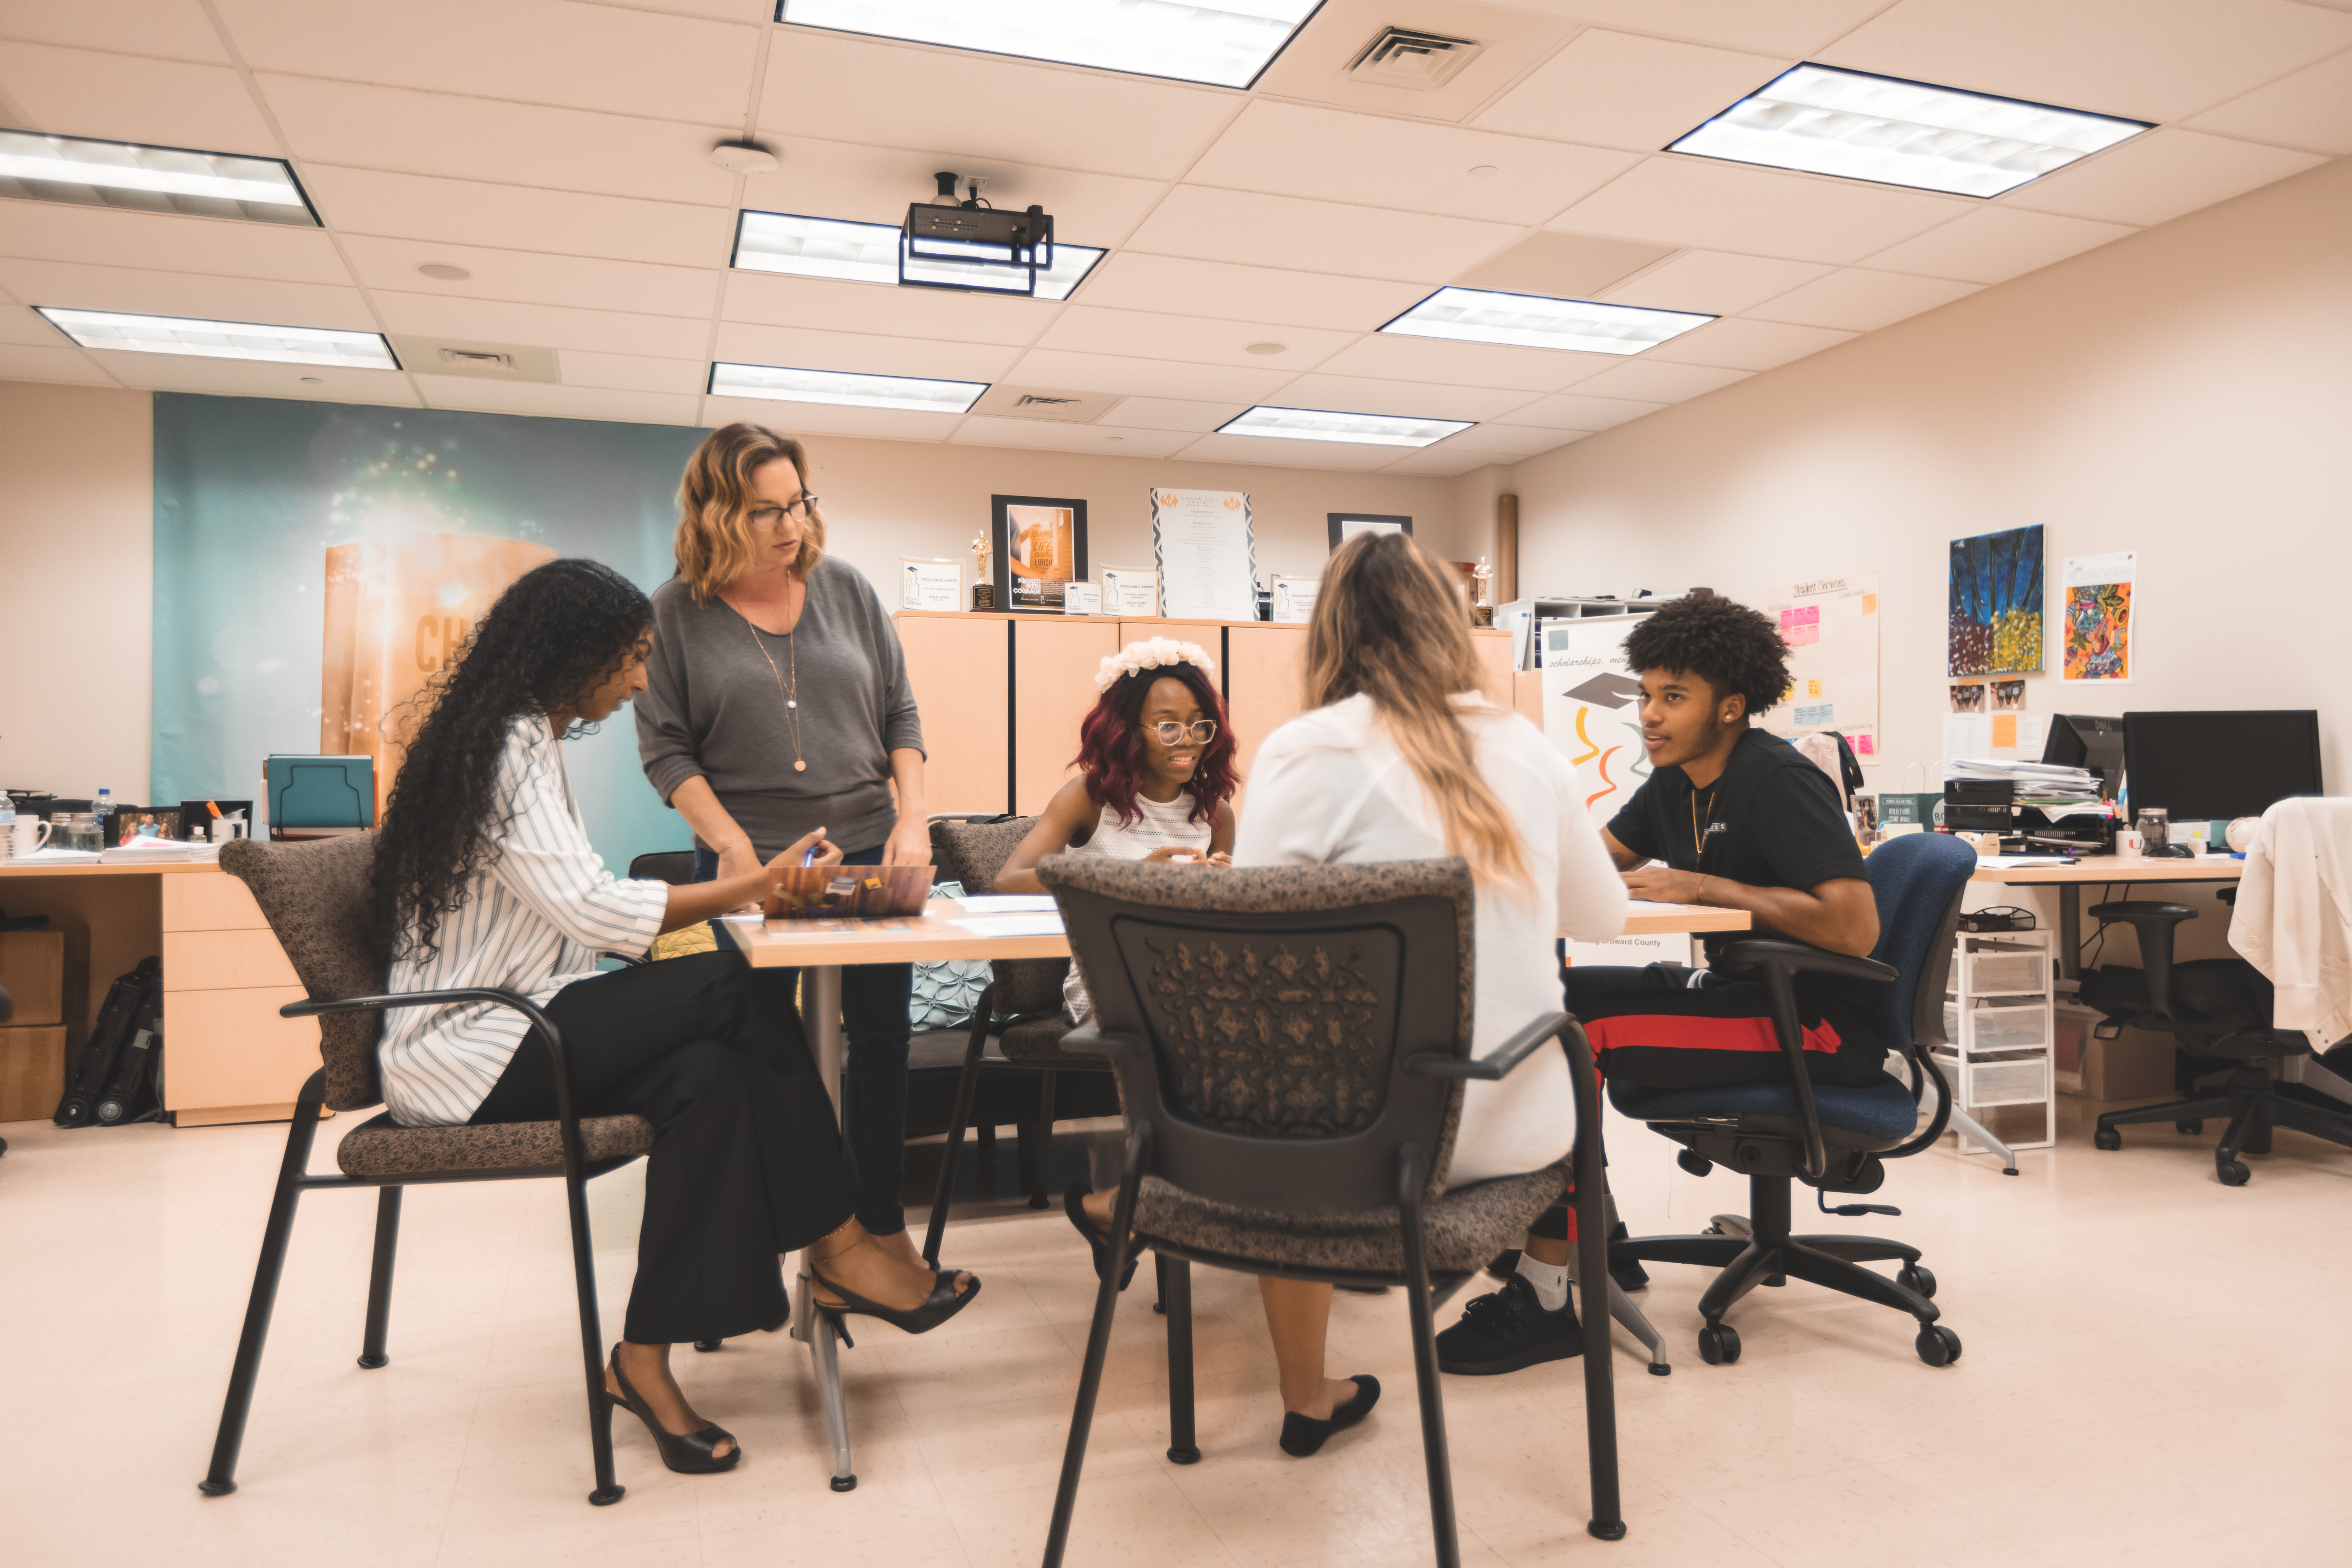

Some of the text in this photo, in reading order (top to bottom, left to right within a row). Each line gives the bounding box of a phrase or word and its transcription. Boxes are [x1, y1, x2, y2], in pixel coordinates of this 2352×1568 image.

[1032, 530, 1052, 538] CHANGE
[1034, 542, 1052, 551] LIFE
[1793, 579, 1845, 596] Student Services
[1634, 939, 1661, 947] County
